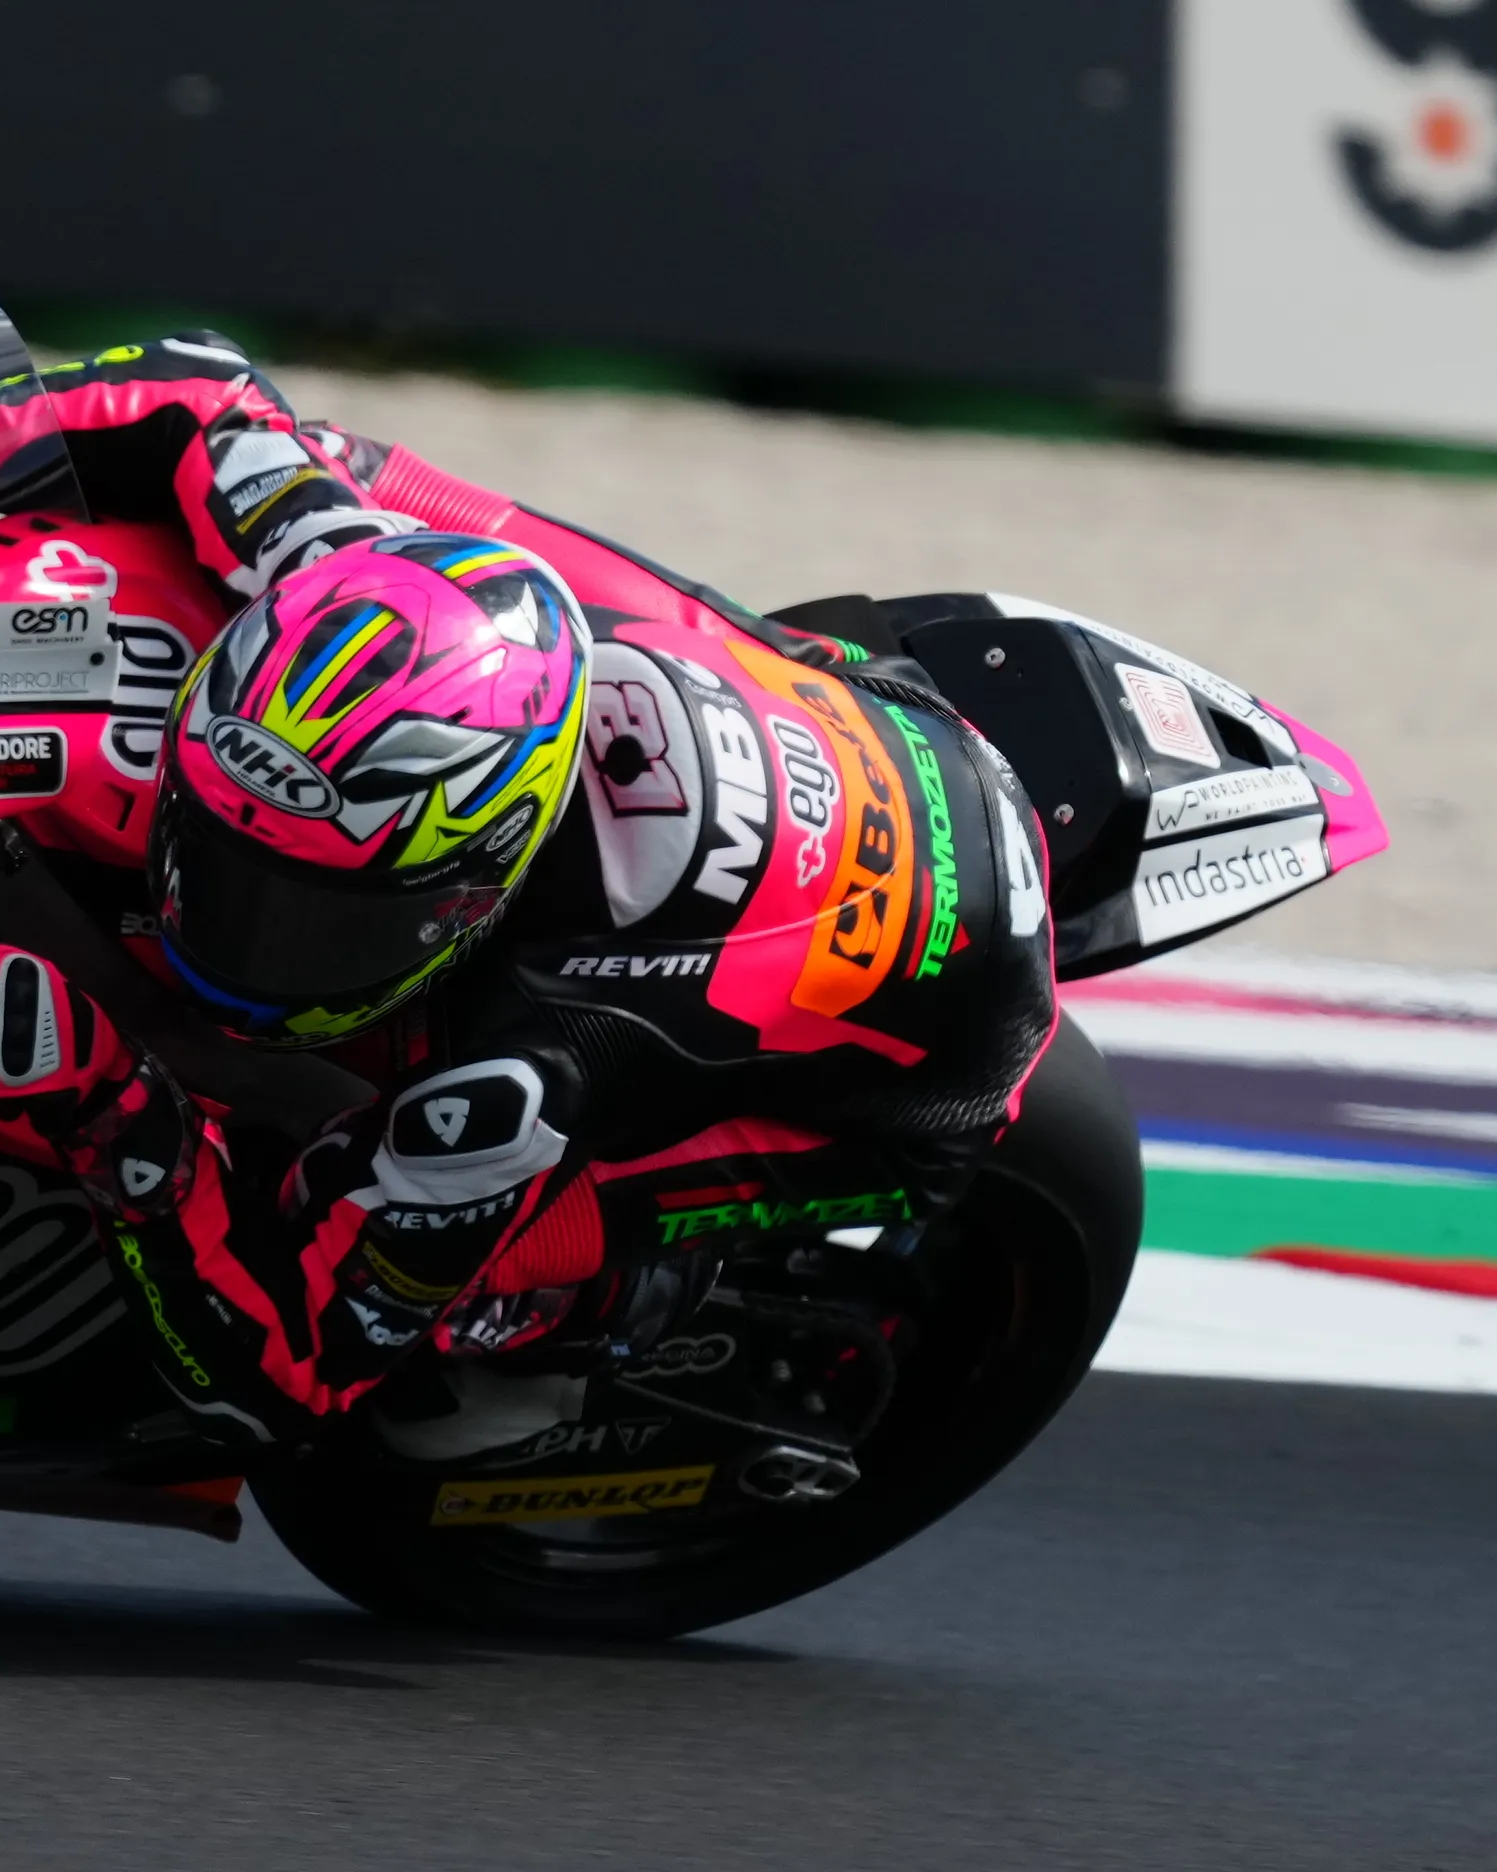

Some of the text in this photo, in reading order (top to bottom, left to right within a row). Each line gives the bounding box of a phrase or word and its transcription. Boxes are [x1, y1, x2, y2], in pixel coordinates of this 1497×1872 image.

[12, 606, 89, 634] esm
[214, 727, 324, 805] NHK
[483, 1478, 706, 1514] DUNLOP
